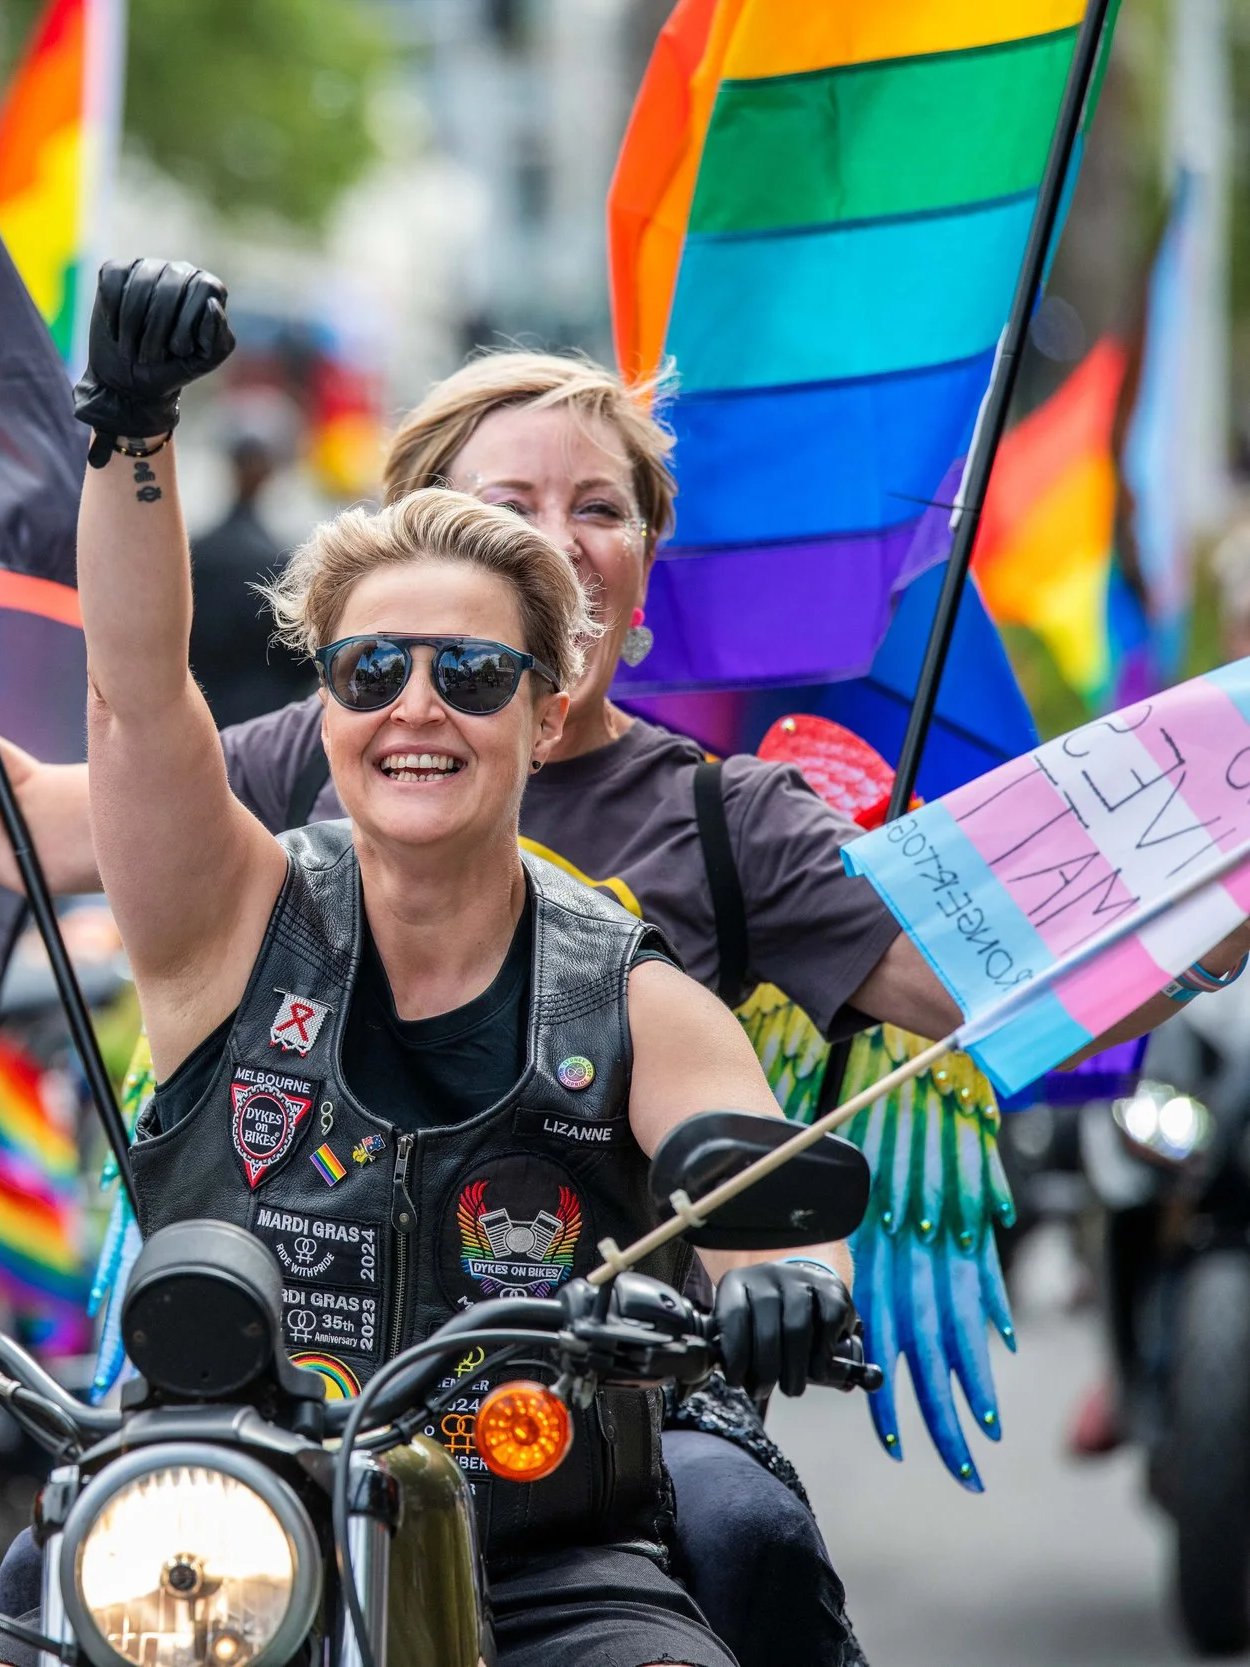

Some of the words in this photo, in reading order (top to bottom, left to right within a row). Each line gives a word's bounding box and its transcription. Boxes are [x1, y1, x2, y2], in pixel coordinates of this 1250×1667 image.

[235, 1067, 311, 1094] MELBOURNE
[246, 1107, 283, 1126] DYKES
[255, 1122, 268, 1133] on
[543, 1118, 613, 1142] LIZANNE
[257, 1209, 309, 1235] MARDI
[312, 1221, 360, 1243] GRAS
[276, 1243, 293, 1267] RIDE
[360, 1228, 376, 1283] 2024
[474, 1263, 508, 1275] DYKES
[510, 1266, 527, 1277] ON
[527, 1267, 559, 1278] BIKES
[281, 1288, 306, 1305] RDI
[311, 1292, 360, 1312] GRAS
[322, 1314, 355, 1332] 35th
[360, 1299, 376, 1351] 2023
[314, 1331, 358, 1347] Anniversary
